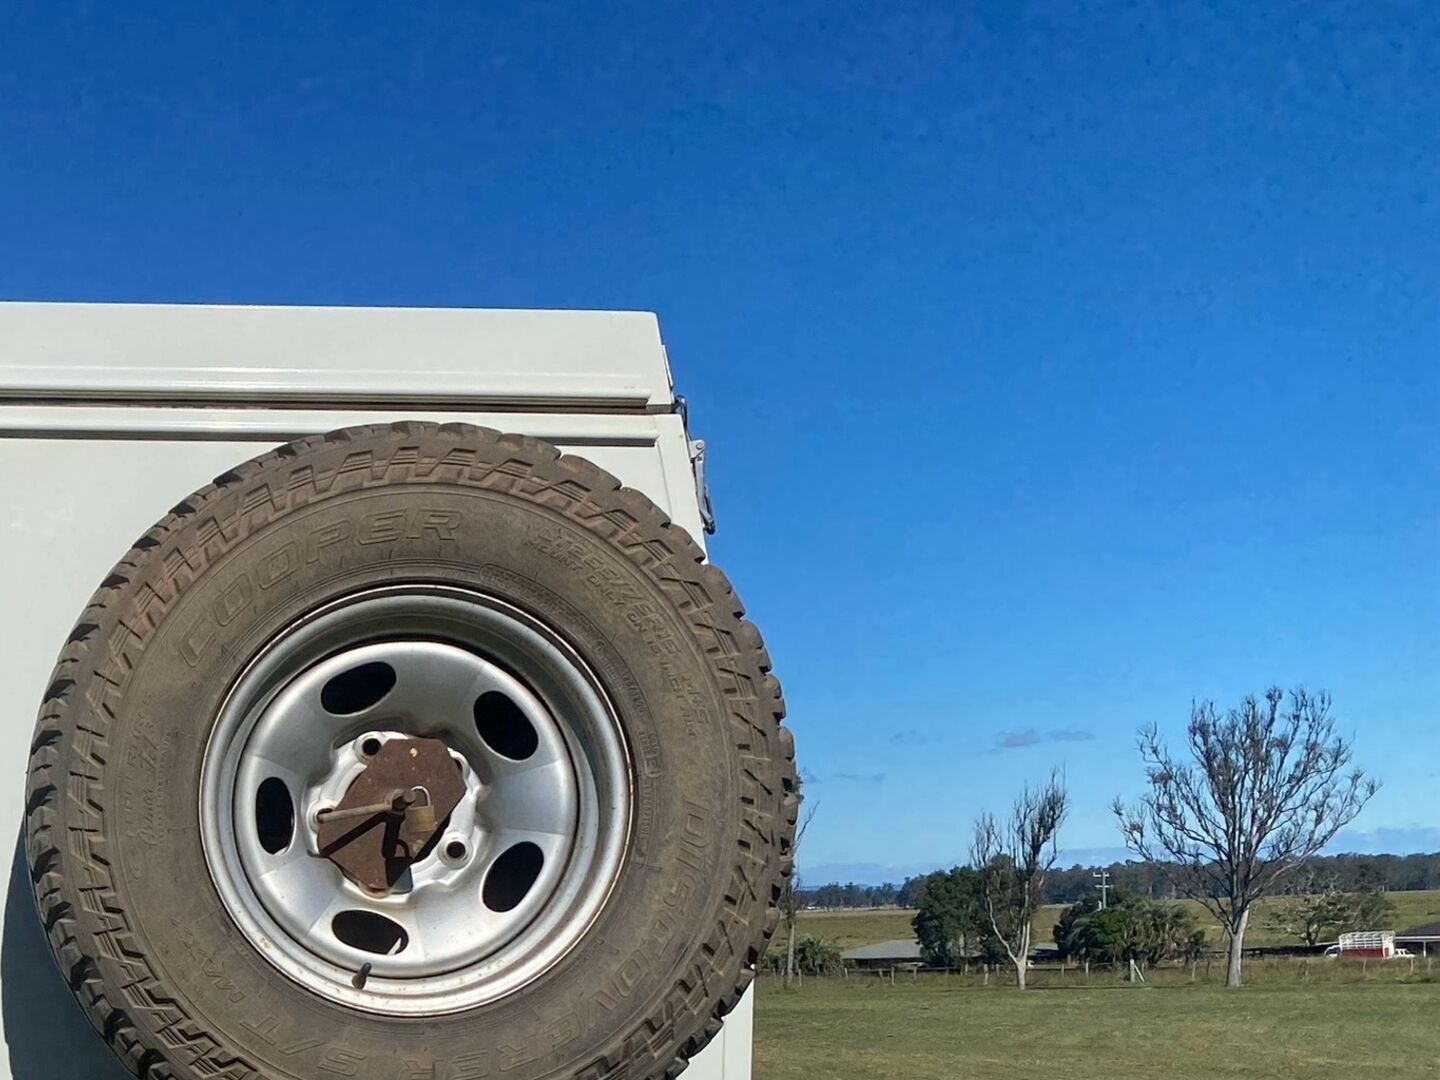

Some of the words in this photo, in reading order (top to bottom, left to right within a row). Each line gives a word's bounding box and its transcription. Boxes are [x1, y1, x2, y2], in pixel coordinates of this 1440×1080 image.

[179, 507, 464, 667] COOPER
[586, 574, 625, 609] ONLY
[627, 610, 649, 635] ON
[239, 1015, 368, 1077] S/T
